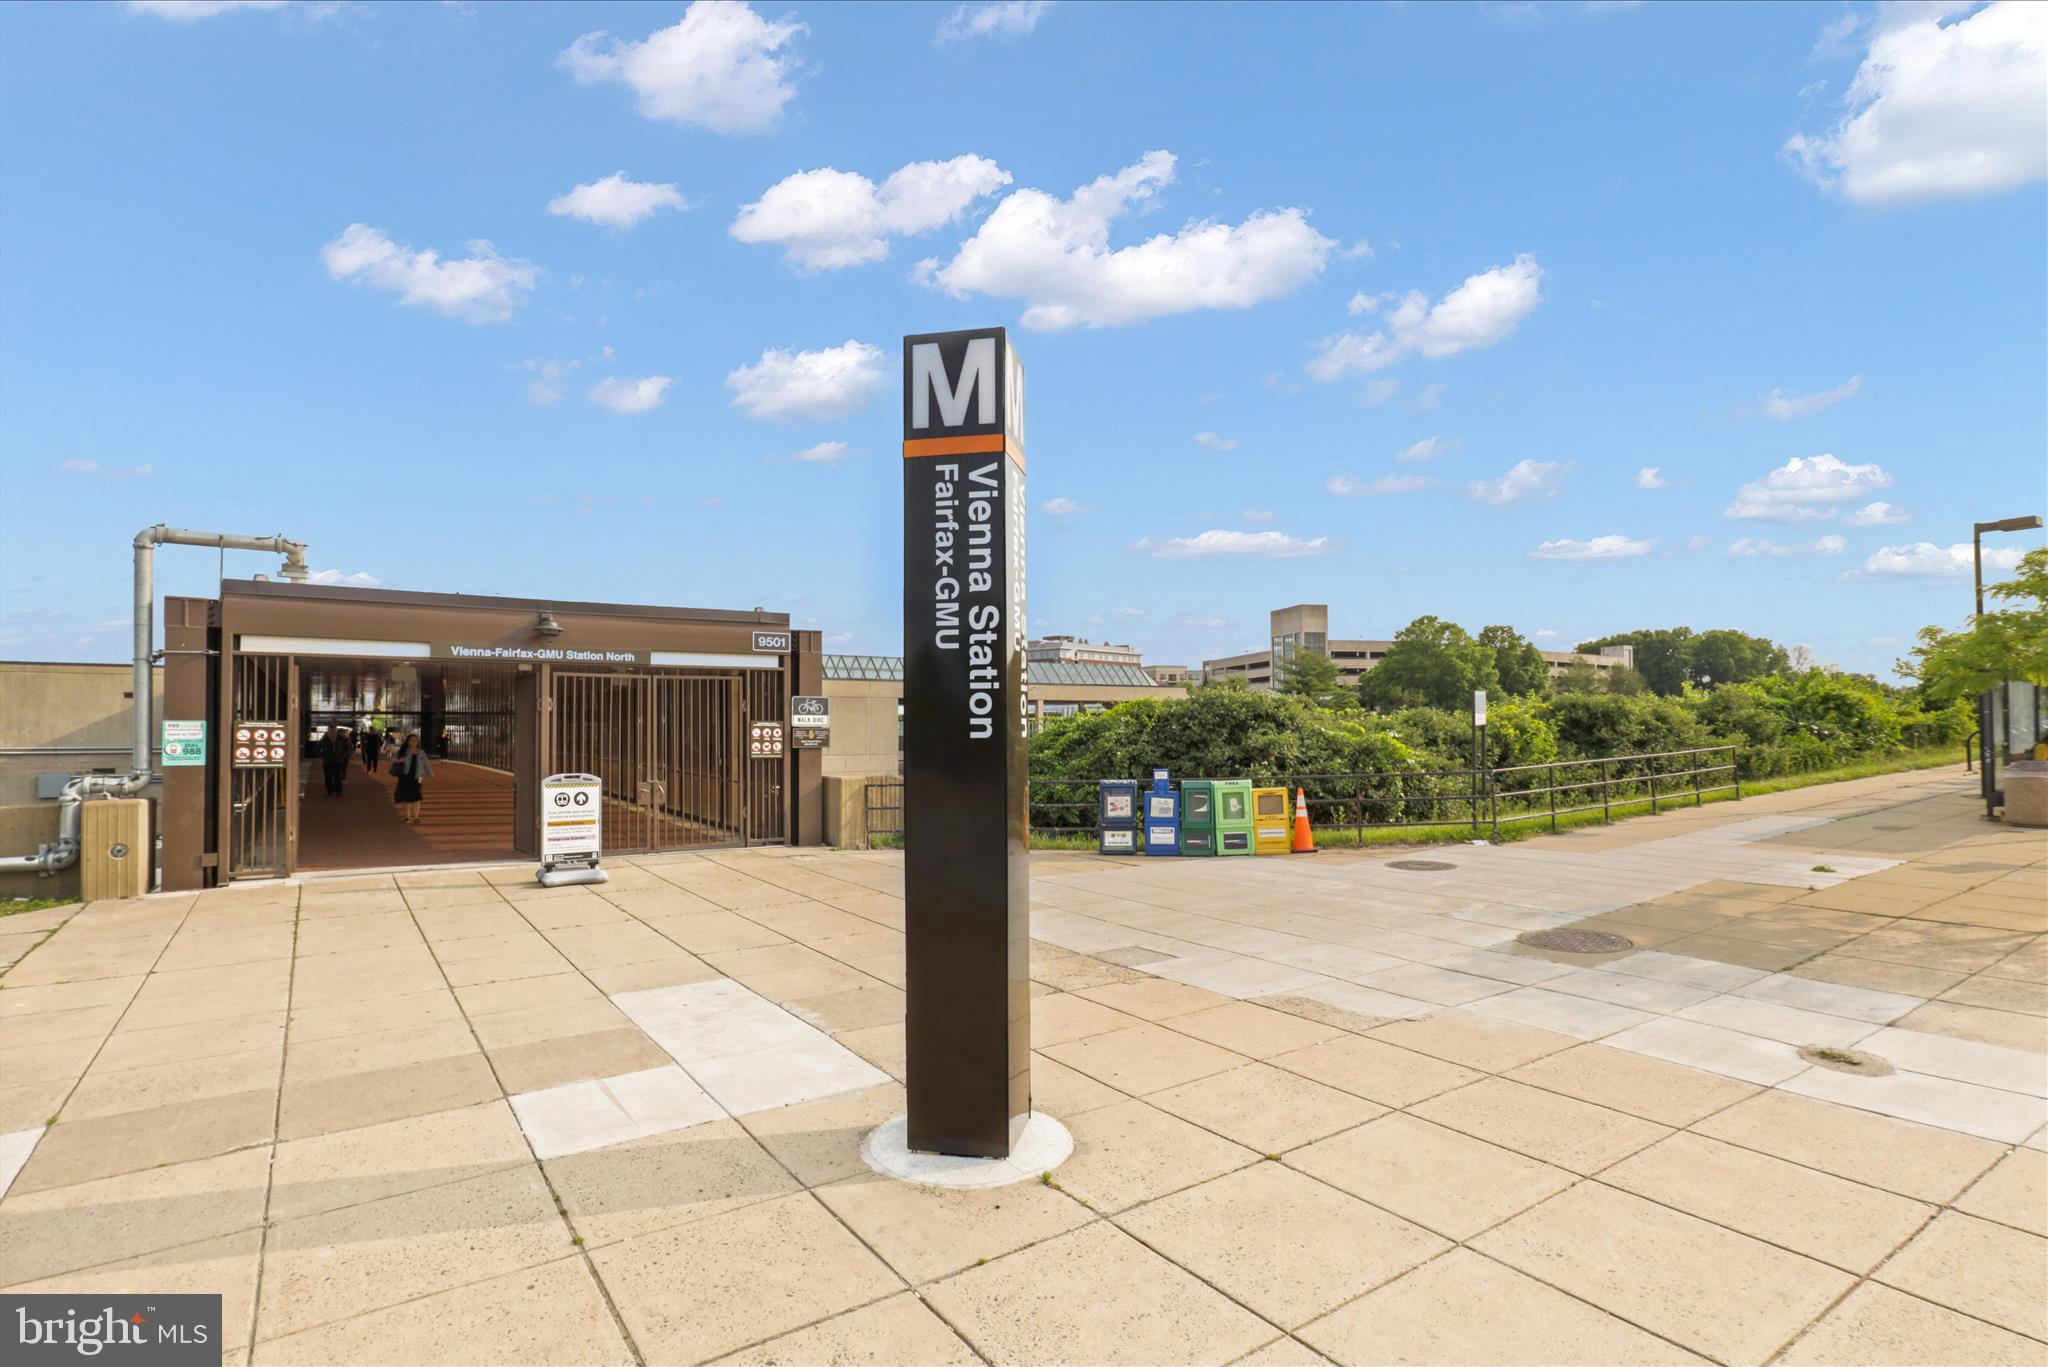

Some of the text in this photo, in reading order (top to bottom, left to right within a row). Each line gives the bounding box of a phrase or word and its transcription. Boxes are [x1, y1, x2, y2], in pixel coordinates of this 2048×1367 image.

[912, 337, 996, 430] M
[935, 463, 960, 650] Fairfax-GMU
[968, 462, 1000, 739] Vienna Station
[450, 646, 635, 662] Vienna-Fairfax-GMU Station North
[758, 636, 786, 648] 9501
[1020, 613, 1028, 738] Station
[182, 747, 202, 756] 988
